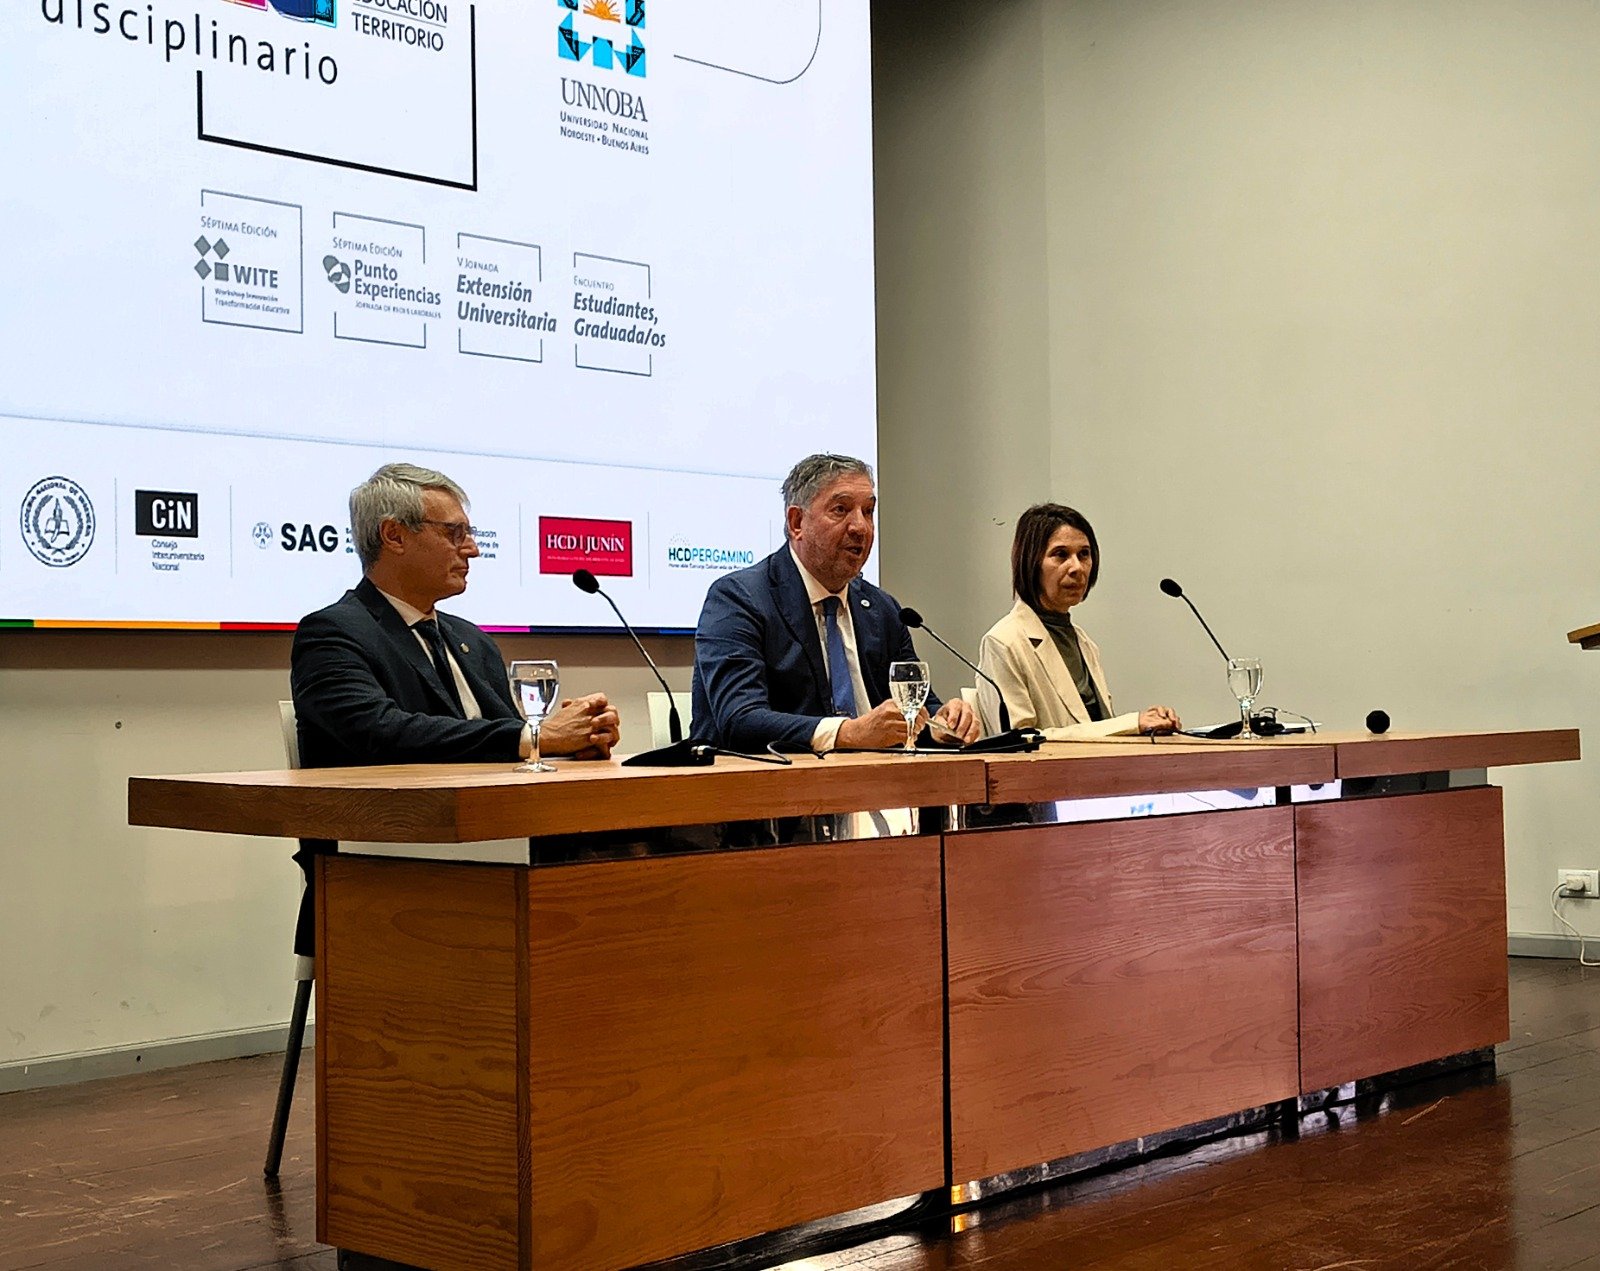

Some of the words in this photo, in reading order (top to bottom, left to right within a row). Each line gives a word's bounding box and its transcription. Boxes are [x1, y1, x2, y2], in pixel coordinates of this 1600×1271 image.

[351, 12, 444, 52] TERRITORIO
[560, 77, 649, 122] UNNOBA
[233, 264, 279, 289] WITE
[354, 259, 398, 281] Punto
[354, 278, 442, 306] Experiencias
[456, 274, 533, 303] Extensión
[457, 300, 558, 333] Universitaria
[573, 292, 659, 325] Estudiantes,
[573, 317, 666, 348] Graduada/os
[151, 498, 192, 530] CiN
[280, 522, 339, 553] SAG
[546, 533, 578, 551] HCD
[668, 547, 755, 564] HCDPERGAMINO
